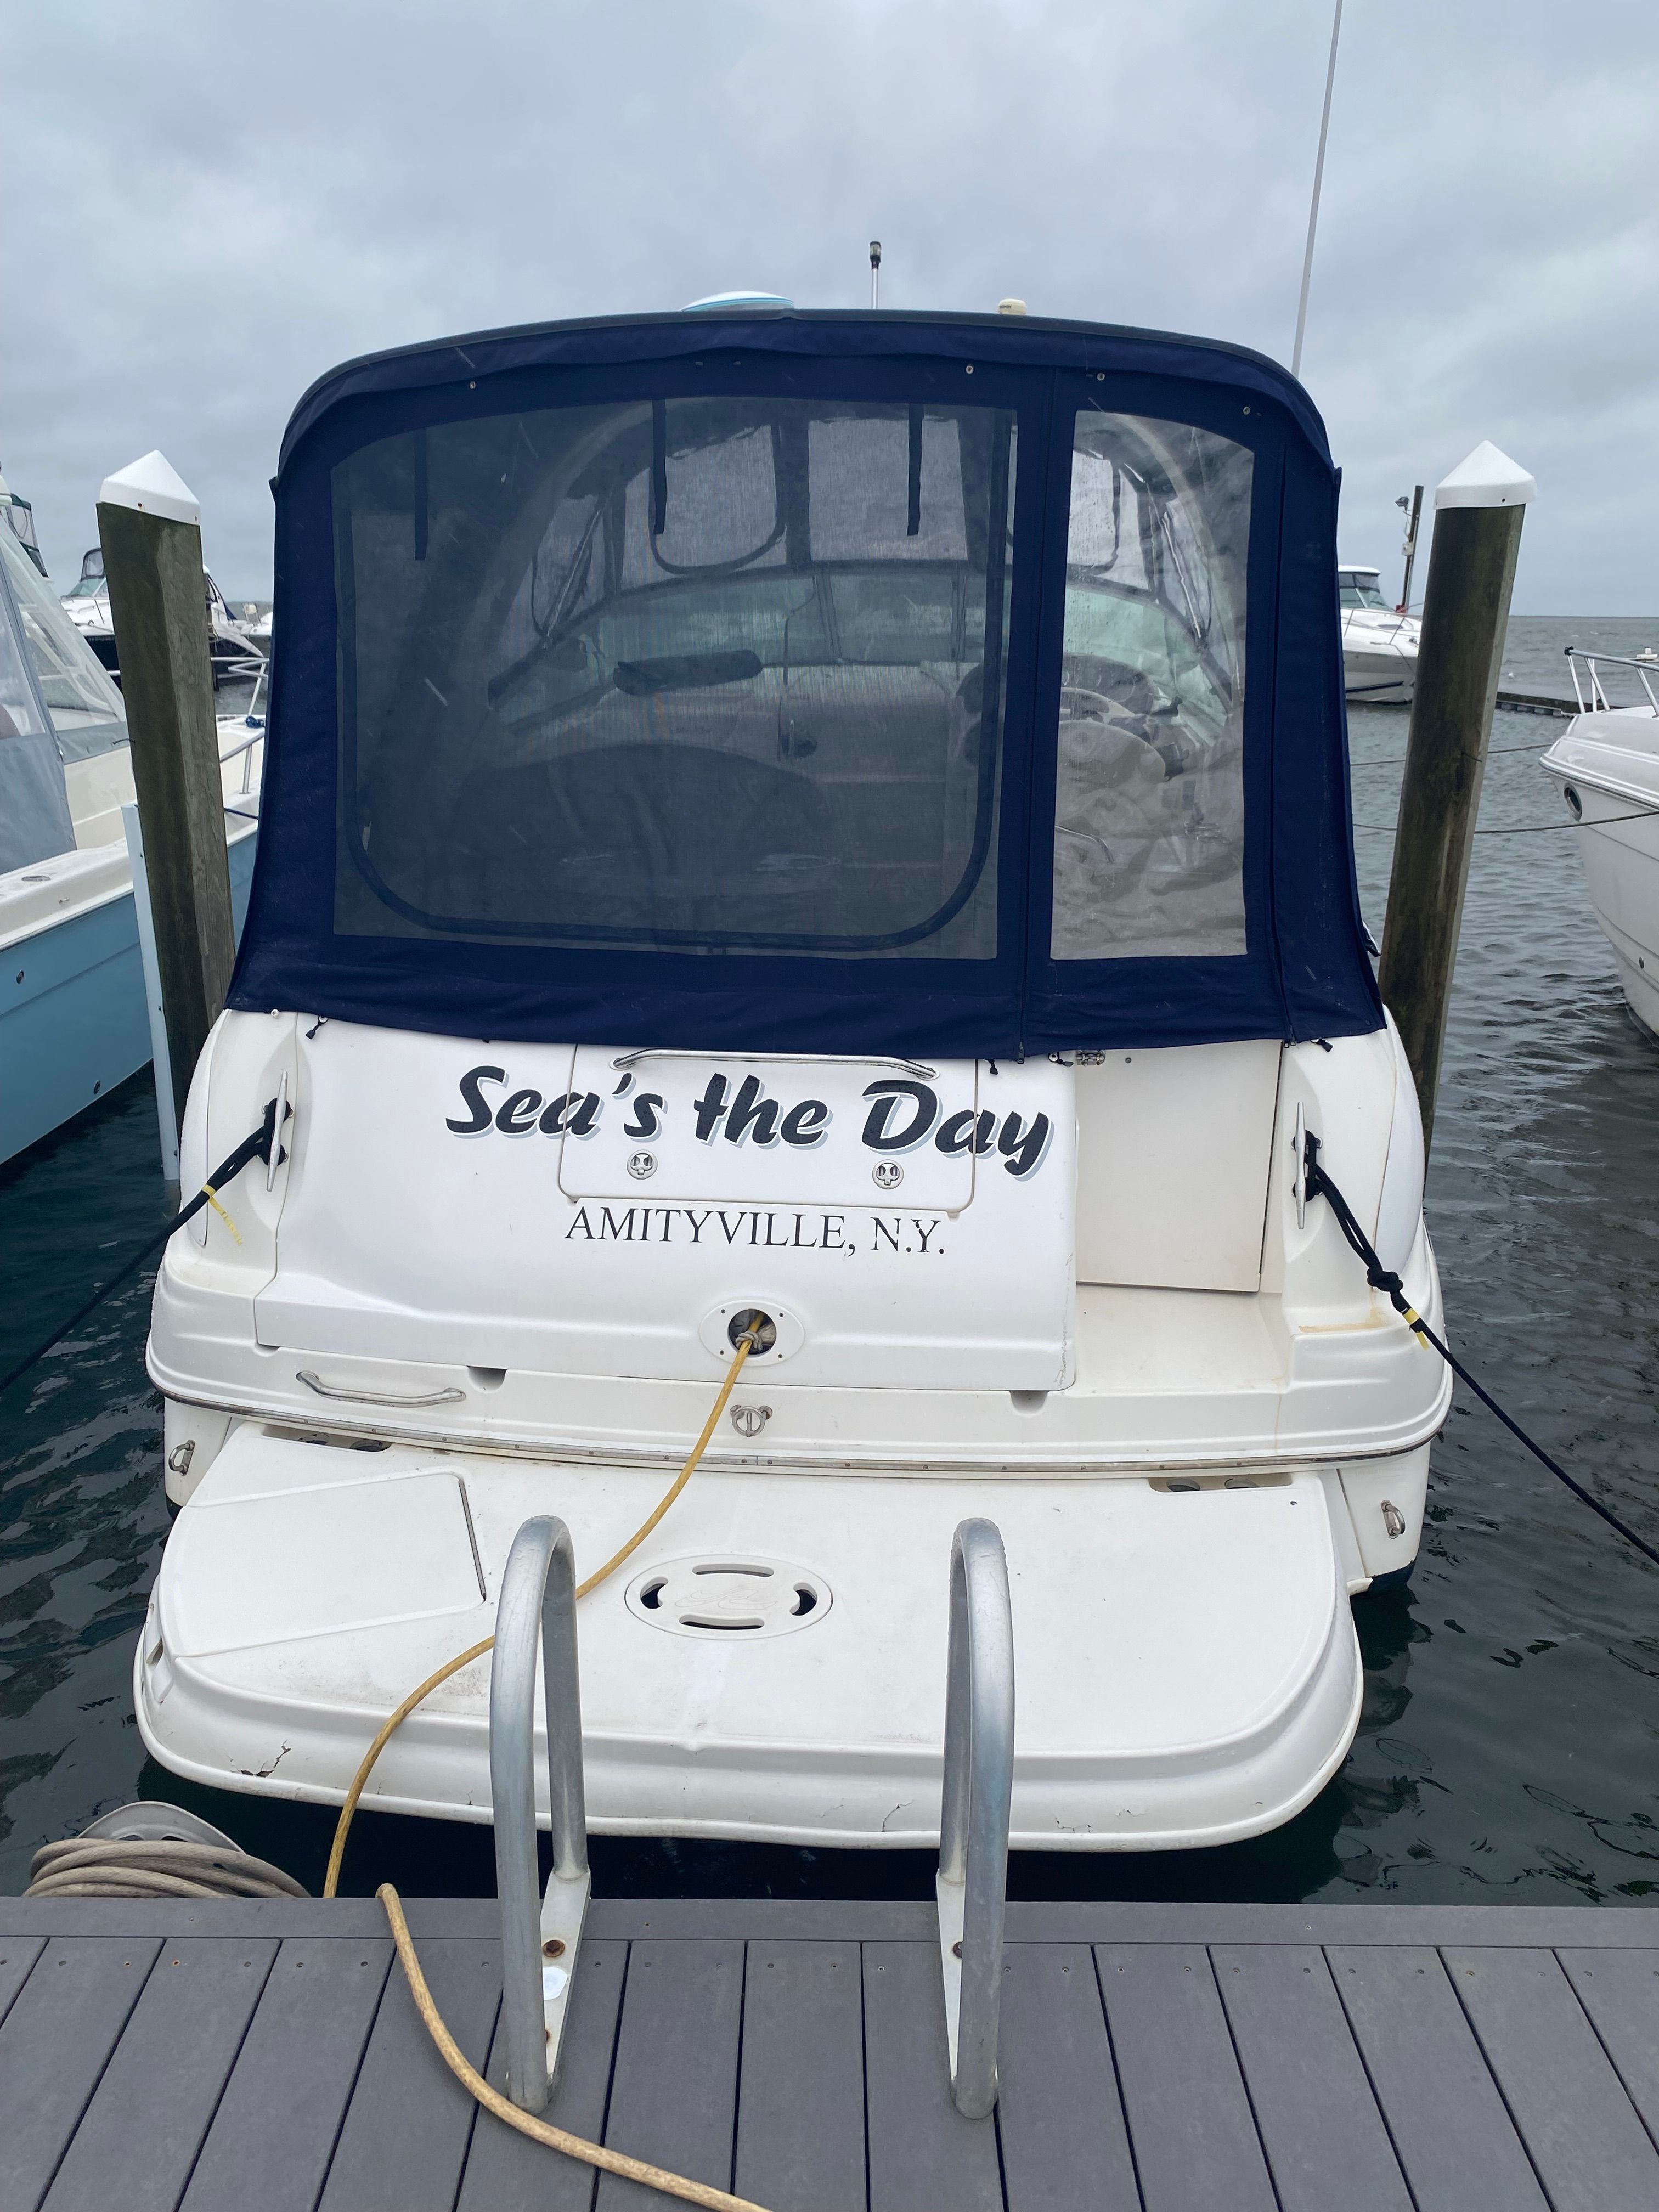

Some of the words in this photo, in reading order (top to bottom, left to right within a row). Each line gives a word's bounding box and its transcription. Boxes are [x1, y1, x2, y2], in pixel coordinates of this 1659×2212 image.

[445, 1065, 666, 1140] Sea's
[693, 1072, 832, 1147] the
[861, 1079, 1053, 1180] Day
[565, 1206, 856, 1257] AMITYVILLE,
[870, 1216, 946, 1255] N.Y.
